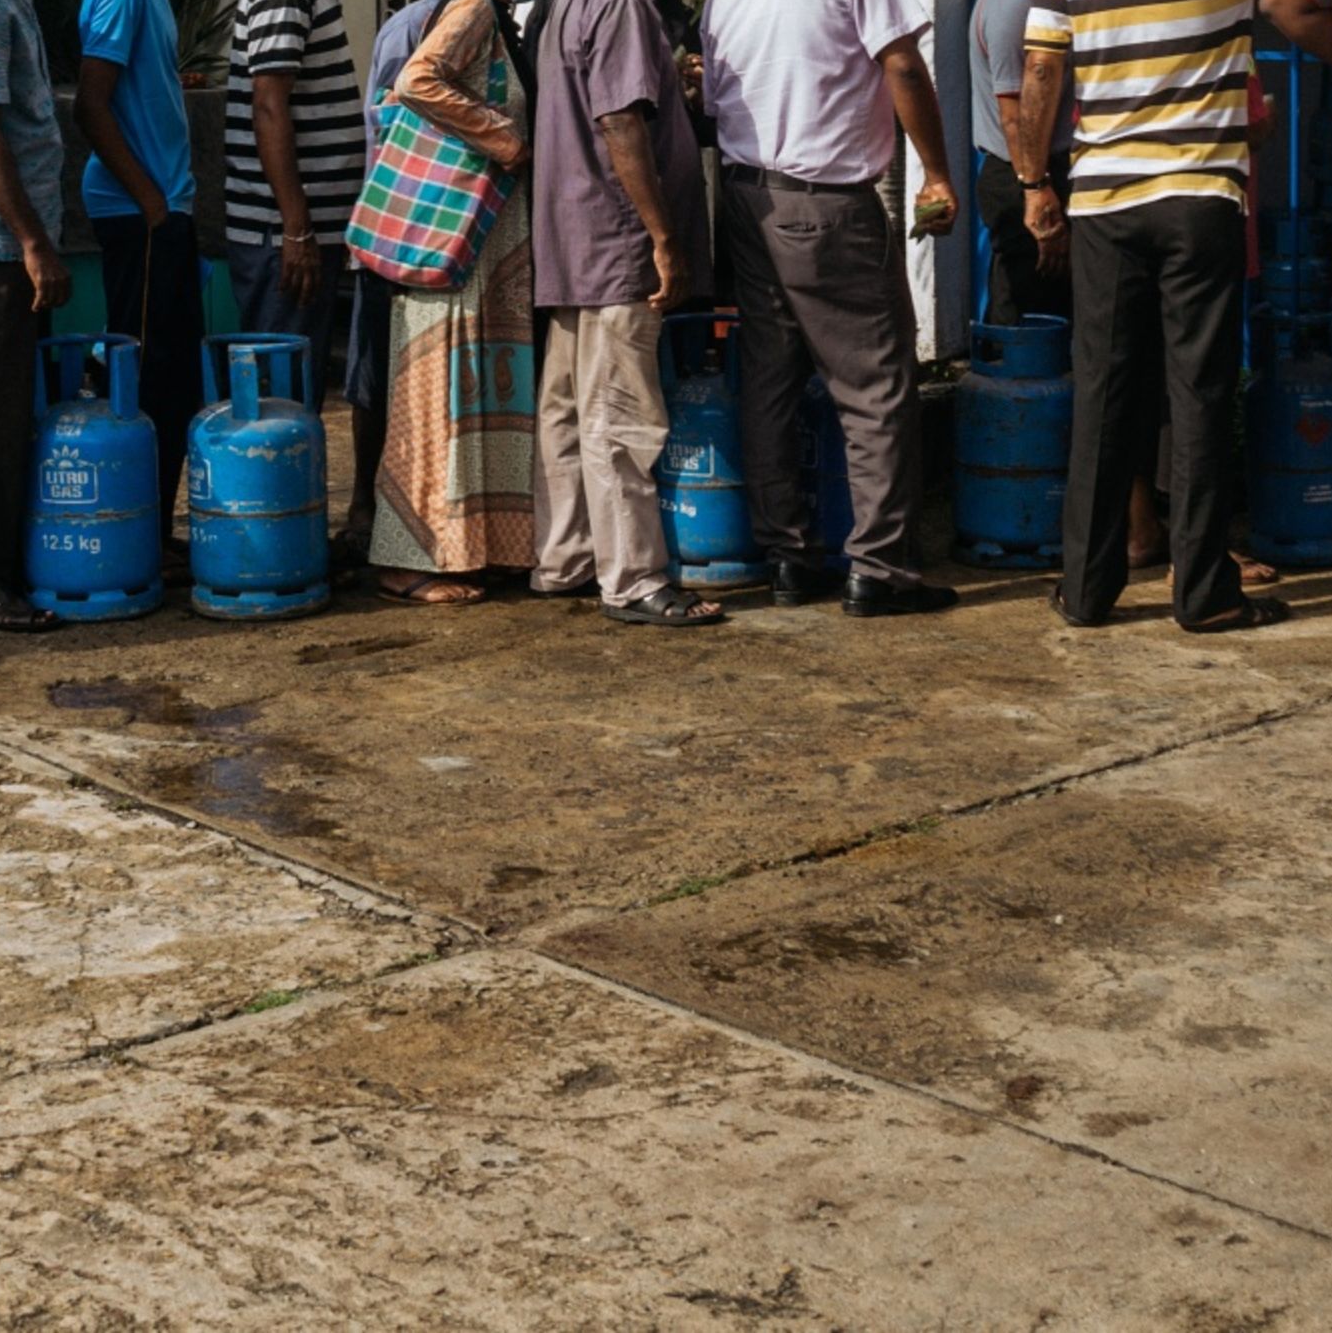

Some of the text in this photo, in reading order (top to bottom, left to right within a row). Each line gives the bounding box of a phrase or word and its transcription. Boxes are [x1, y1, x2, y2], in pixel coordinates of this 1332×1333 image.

[45, 470, 89, 485] LITRO
[50, 484, 83, 499] GAS
[41, 534, 102, 555] 12.5 kg
